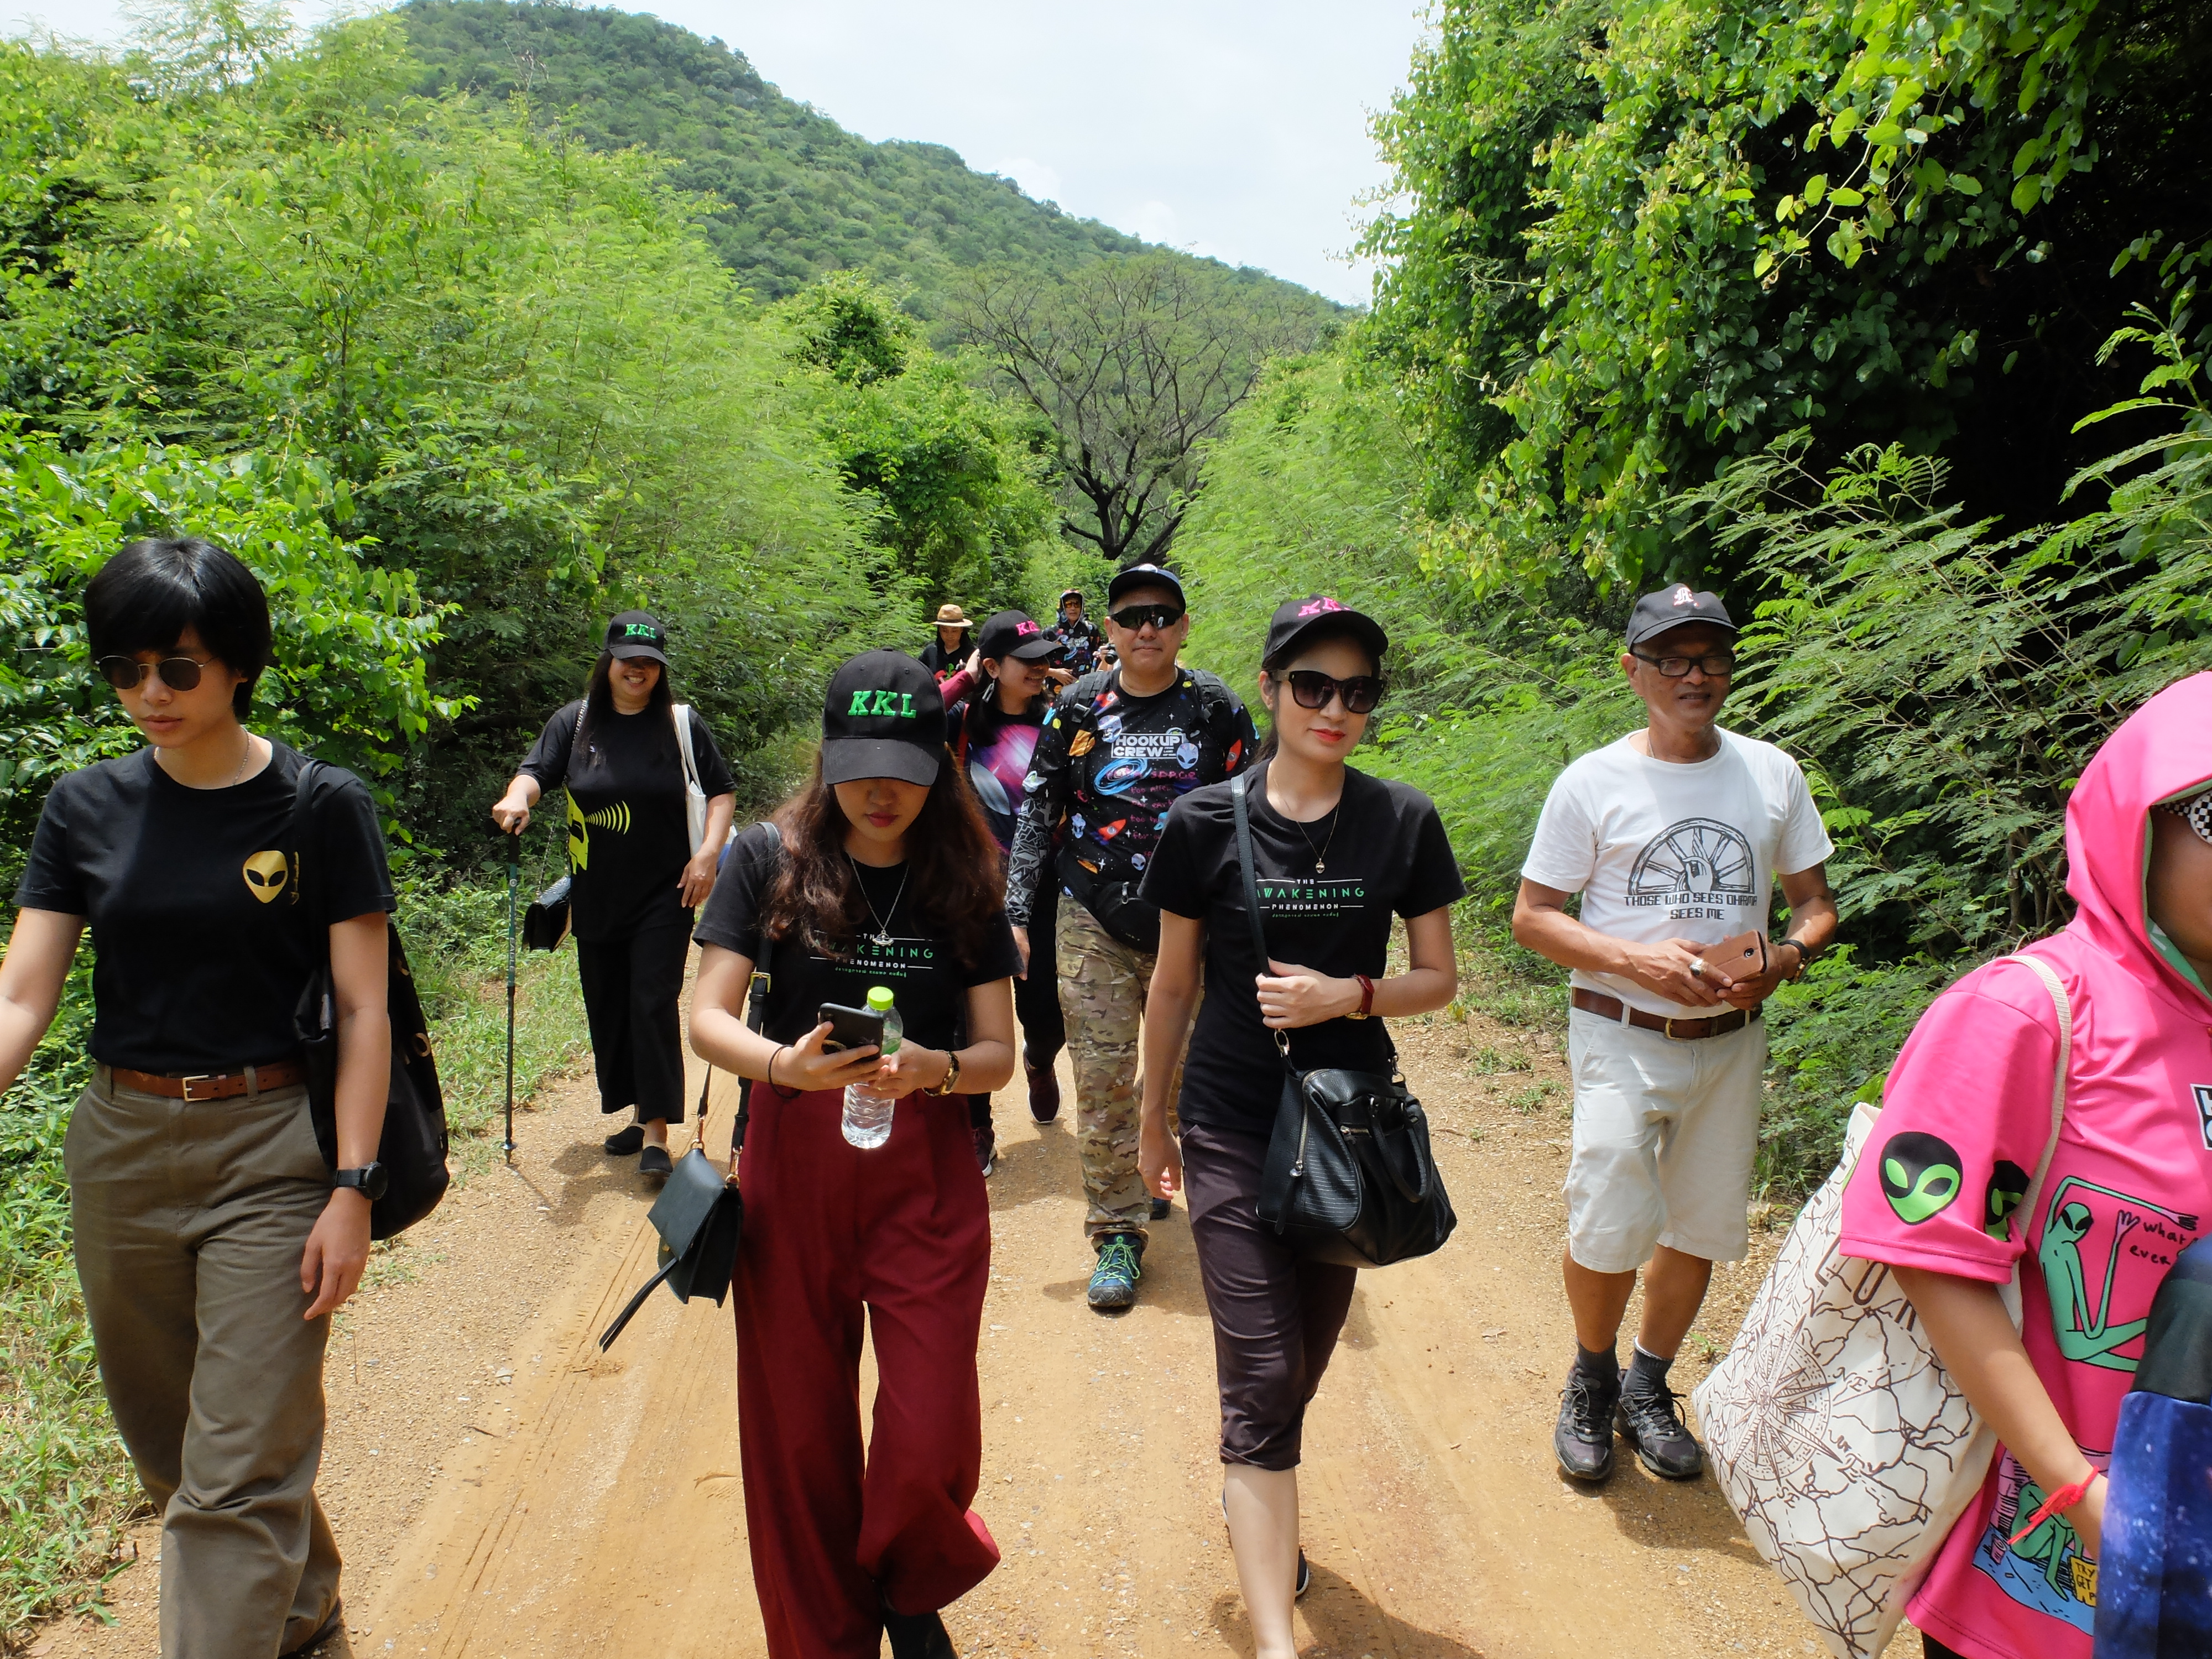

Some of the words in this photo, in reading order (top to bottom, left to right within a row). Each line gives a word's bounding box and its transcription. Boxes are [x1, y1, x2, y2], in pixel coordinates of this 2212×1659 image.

[1298, 597, 1350, 617] KK
[625, 623, 657, 639] KKL
[848, 690, 916, 718] KKL
[1113, 747, 1163, 757] CREW
[1624, 895, 1661, 906] THOSE
[1665, 893, 1689, 905] WHO
[1693, 892, 1723, 905] SEES
[1670, 907, 1703, 920] SEES
[1707, 907, 1725, 920] ME
[829, 942, 933, 959] AKENING
[835, 956, 906, 969] PHENOMENON
[2074, 1562, 2095, 1578] TRY
[2076, 1574, 2092, 1590] GET
